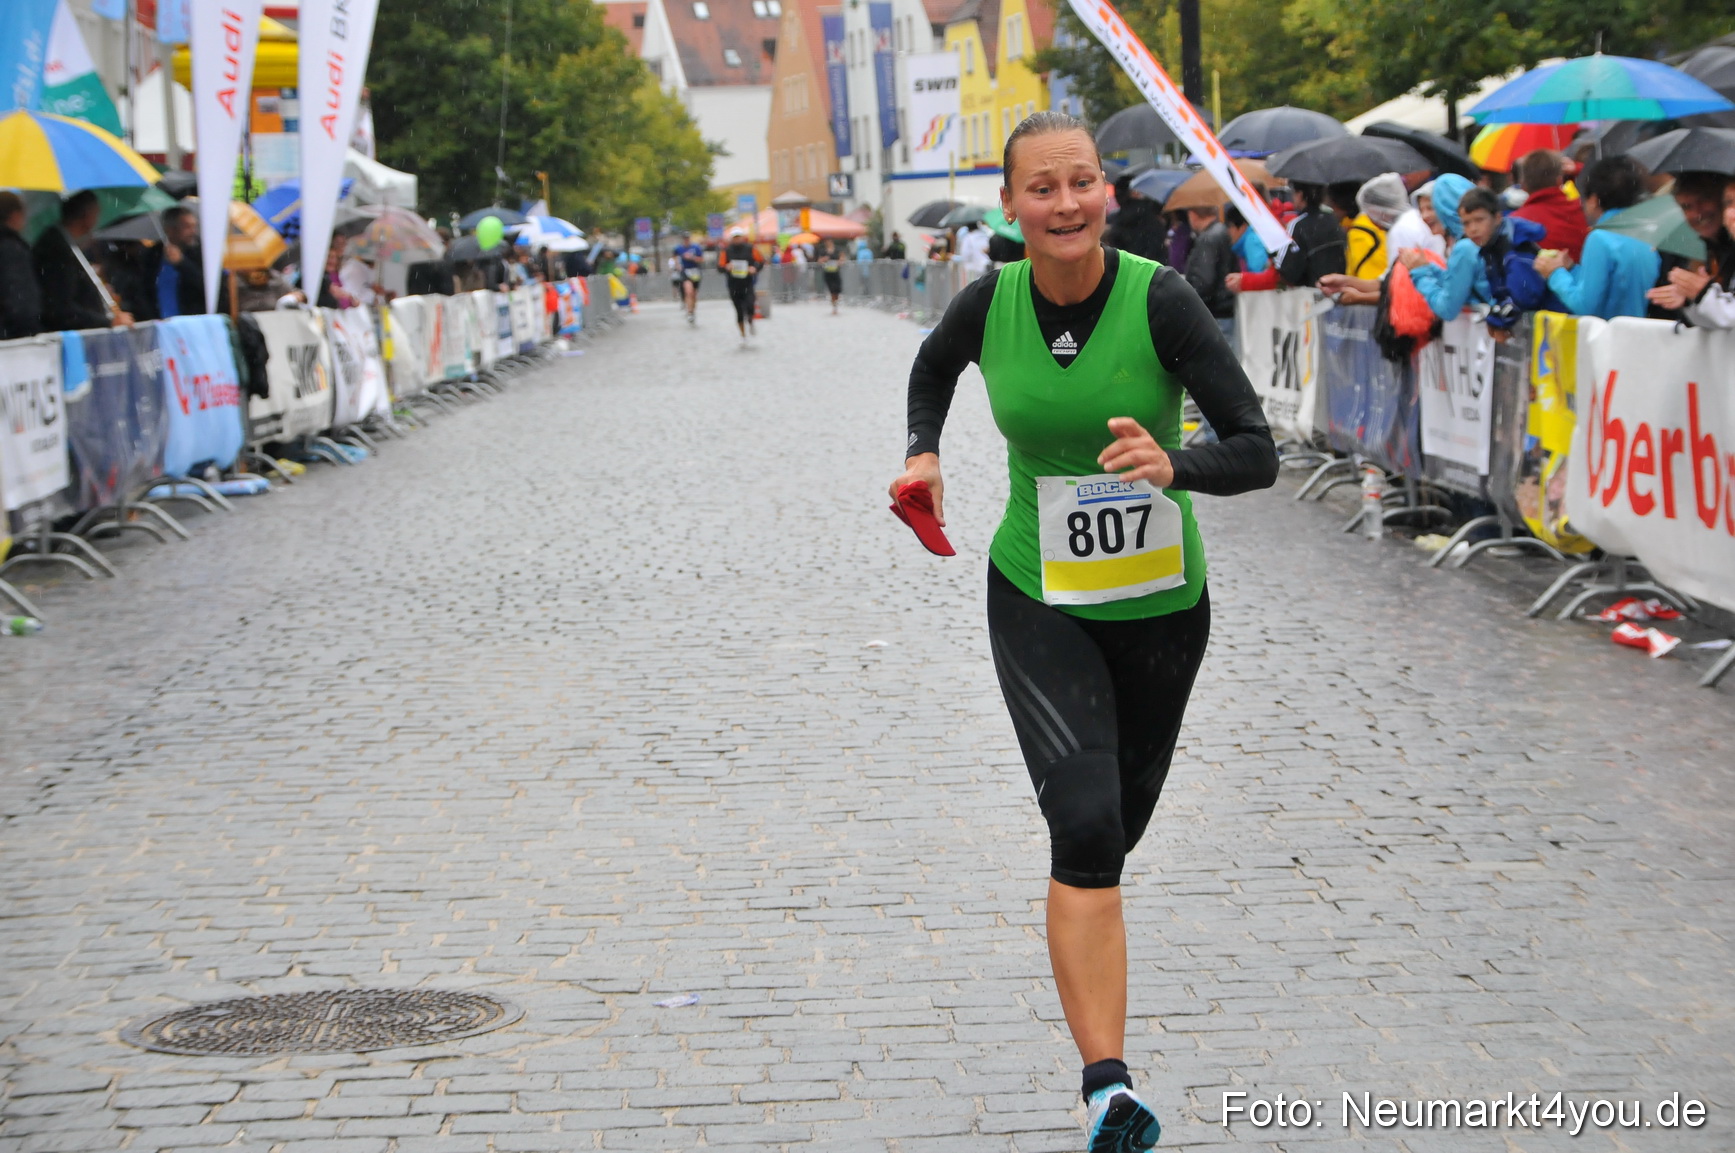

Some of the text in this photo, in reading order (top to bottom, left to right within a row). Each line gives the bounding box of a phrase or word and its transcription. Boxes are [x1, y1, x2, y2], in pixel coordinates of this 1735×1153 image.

[214, 9, 245, 119] Audi
[318, 49, 345, 141] Audi
[1077, 481, 1135, 498] BOCK
[1067, 503, 1153, 558] 807
